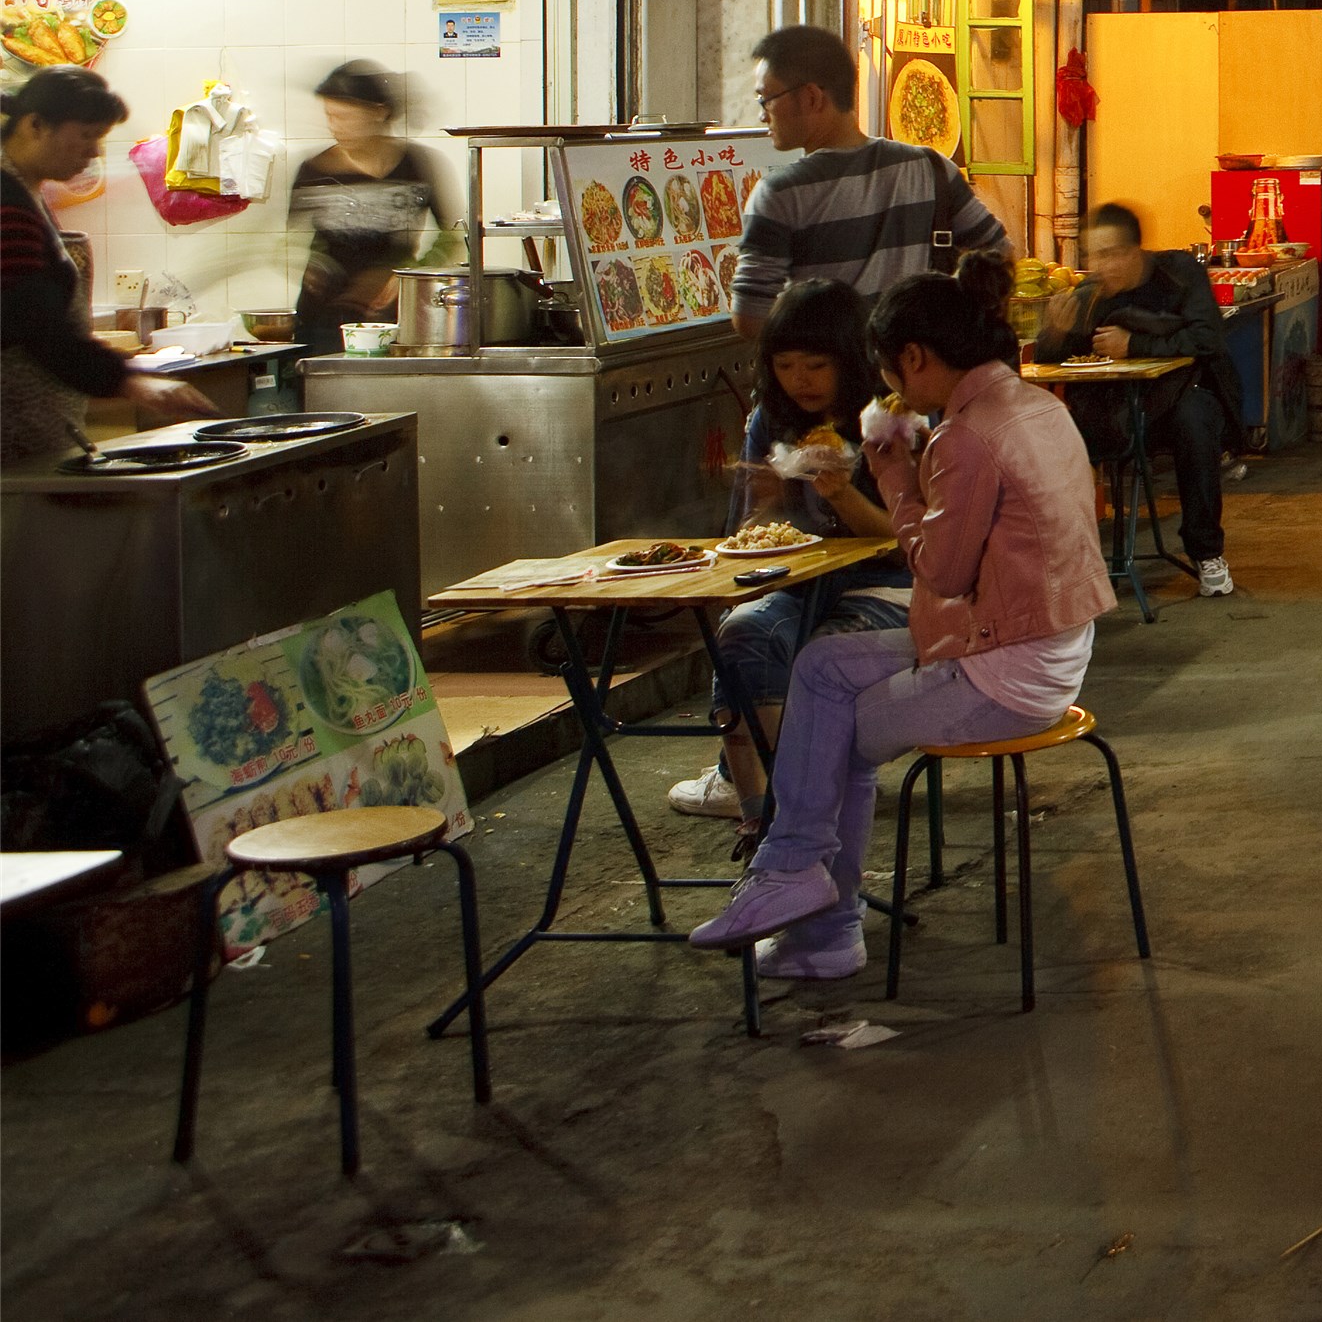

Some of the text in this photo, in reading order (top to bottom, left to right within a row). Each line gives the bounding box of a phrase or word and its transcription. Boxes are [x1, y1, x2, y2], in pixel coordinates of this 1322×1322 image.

[629, 145, 744, 172] 特色小吃
[353, 704, 387, 730] 鱼丸面
[231, 736, 315, 785] 海蛎煎 10元/份
